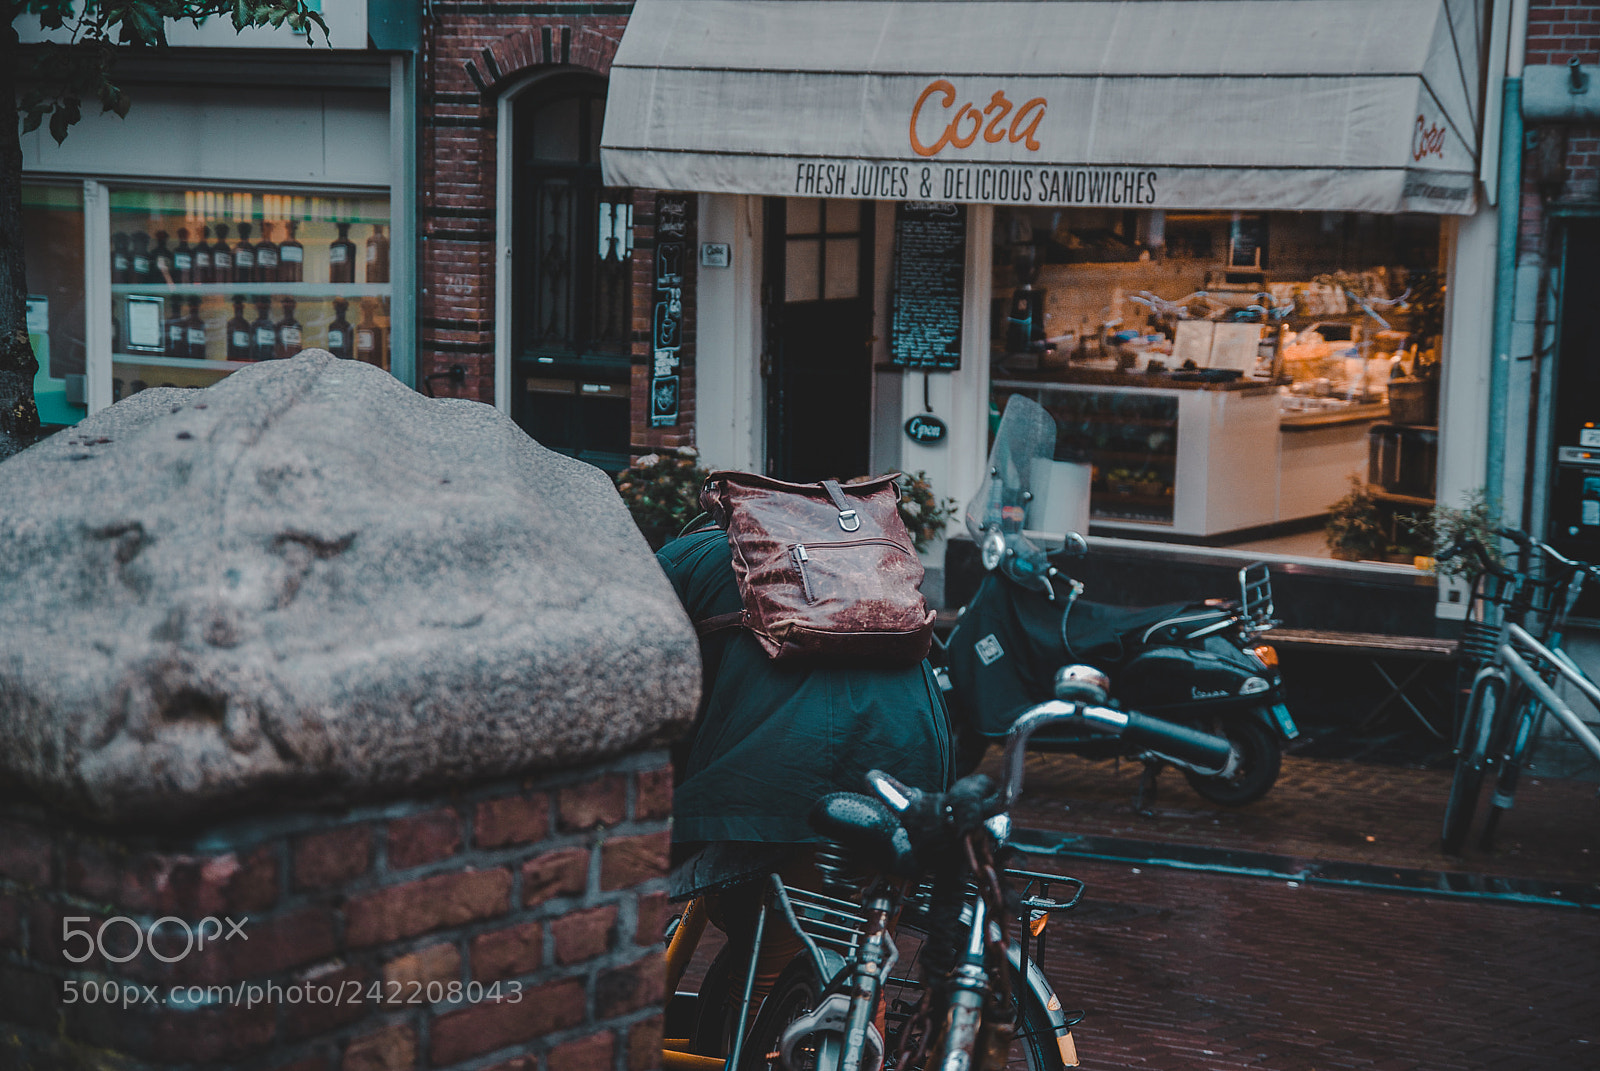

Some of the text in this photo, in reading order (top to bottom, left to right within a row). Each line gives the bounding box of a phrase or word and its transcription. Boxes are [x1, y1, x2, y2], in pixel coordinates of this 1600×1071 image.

[909, 79, 1048, 157] Cora
[1412, 114, 1446, 162] Cora
[795, 162, 1158, 205] FRESH JUICES & DELICIOUS SANDWICHES
[909, 417, 941, 440] Open
